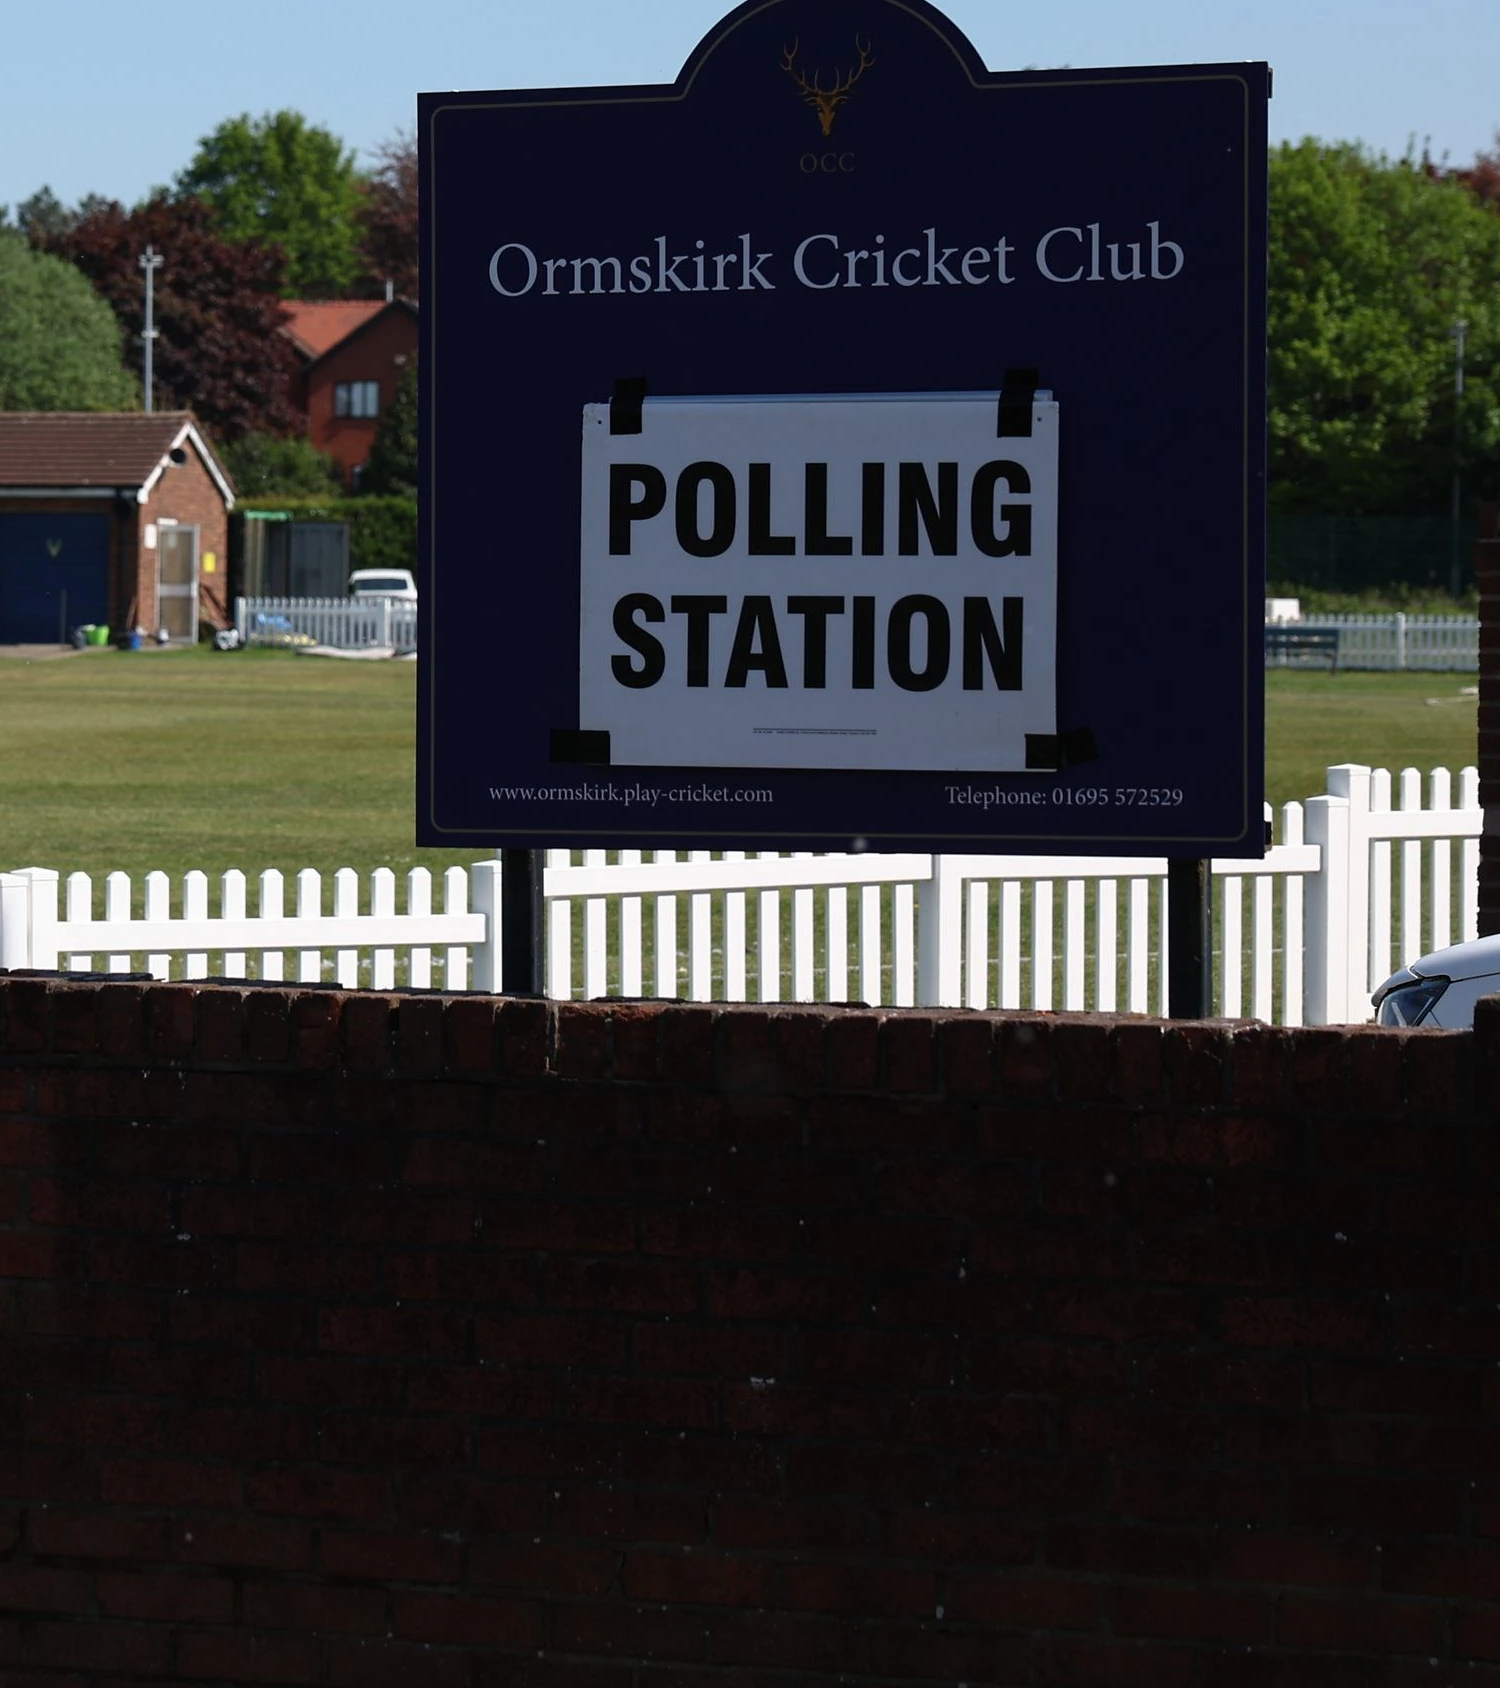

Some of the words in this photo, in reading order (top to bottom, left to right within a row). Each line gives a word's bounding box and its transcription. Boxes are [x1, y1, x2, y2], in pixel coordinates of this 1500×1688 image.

[799, 152, 856, 174] OCC
[488, 232, 776, 297] Ormskirk
[793, 227, 1016, 290] Cricket
[1035, 220, 1186, 284] Club
[608, 459, 1033, 559] POLLING
[610, 592, 1025, 693] STATION
[489, 782, 774, 807] www.ormskirk.play-cricket.com
[944, 785, 1047, 810] Telephone:
[1052, 787, 1109, 806] 01695
[1115, 788, 1184, 807] 572529
